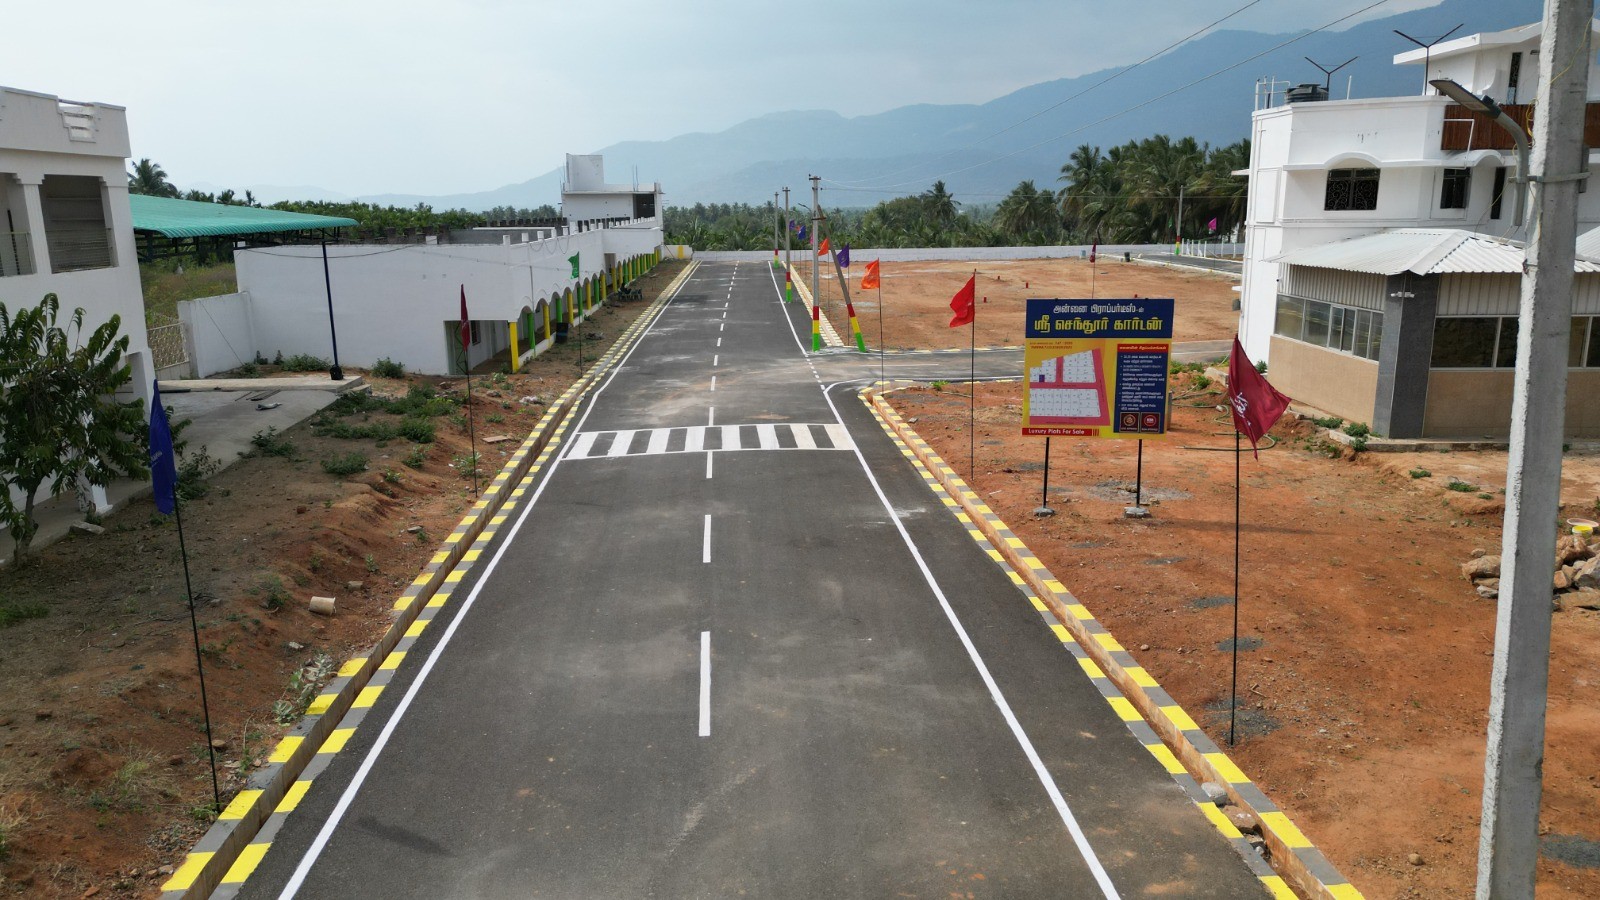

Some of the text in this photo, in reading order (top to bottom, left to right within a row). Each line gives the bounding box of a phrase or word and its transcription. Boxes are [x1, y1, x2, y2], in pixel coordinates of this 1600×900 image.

[1053, 304, 1088, 313] அன்னை
[1055, 316, 1109, 334] செந்தூர்
[1113, 316, 1163, 331] கார்டன்
